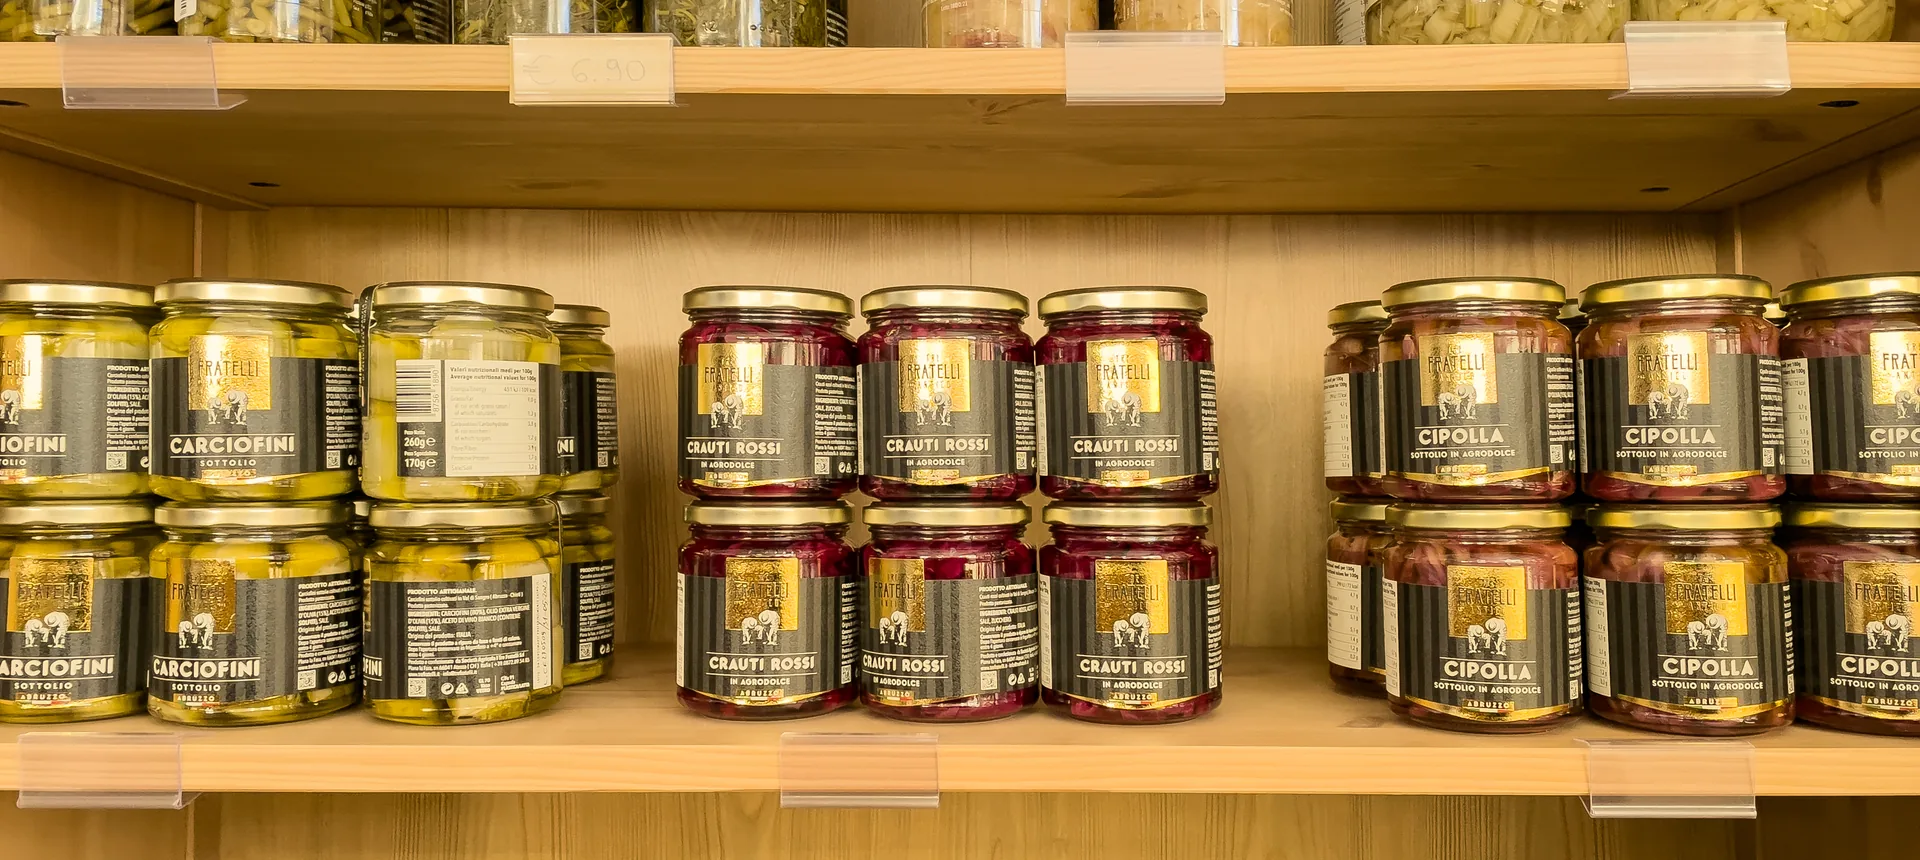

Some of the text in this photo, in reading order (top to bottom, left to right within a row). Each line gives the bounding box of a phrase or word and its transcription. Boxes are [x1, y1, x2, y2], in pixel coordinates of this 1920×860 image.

[571, 58, 646, 83] 6.90
[1428, 354, 1485, 373] FRATELLI
[1637, 353, 1698, 371] FRATELLI
[1882, 353, 1918, 370] FRAT
[199, 361, 259, 377] FRATELLI
[704, 366, 753, 383] FRATELLI
[907, 364, 960, 381] FRATELLI
[1096, 364, 1150, 380] FRATELLI
[404, 437, 426, 448] 260g
[1418, 428, 1505, 445] CIPOLLA
[1625, 427, 1717, 444] CIPOLLA
[170, 436, 295, 454] CARCIOFINI
[687, 441, 781, 455] CRAUTI ROSSI
[886, 438, 989, 452] CRAUTI ROSSI
[1073, 439, 1178, 453] CRAUTI ROSSI
[1410, 449, 1516, 459] SOTTOLIO IN AGRODOLCE
[1616, 450, 1657, 458] SOTTOLIO
[1672, 450, 1728, 458] AGRODOLCE
[200, 459, 256, 467] SOTTOLIO
[404, 459, 426, 470] 170g
[700, 461, 755, 469] IN AGRODOLCE
[916, 458, 966, 466] AGRODOLCE
[873, 581, 916, 600] FRATELLI
[1105, 583, 1159, 601] FRATELLI
[1457, 586, 1516, 606] FRATELLI
[1676, 583, 1737, 602] FRATELLI
[1855, 583, 1919, 603] FRATELLI
[153, 658, 260, 678] CARCIOFINI
[709, 655, 815, 671] CRAUTI ROSSI
[863, 654, 945, 673] CRAUTI ROSSI
[1080, 660, 1186, 674] CRAUTI ROSSI
[1444, 660, 1532, 680] CIPOLLA
[1663, 658, 1754, 676] CIPOLLA
[1841, 656, 1920, 677] CIPOLL
[14, 682, 73, 690] SOTTOLIO
[172, 683, 221, 692] SOTTOLIO
[740, 677, 790, 686] AGRODOLCE
[879, 677, 920, 687] AGRODOLCE
[1113, 681, 1163, 689] AGRODOLCE
[1433, 681, 1541, 694] SOTTOLIO IN AGRODOLCE
[1651, 679, 1764, 690] SOTTOLIO IN AGRODOLCE
[1830, 677, 1876, 689] SOTTOLIO
[1892, 683, 1920, 691] AGRO
[740, 689, 779, 697] ABRUZZO
[879, 689, 910, 697] ABRUZZO
[1113, 692, 1152, 700] ABRUZZO
[1467, 701, 1509, 709] ABRUZZO
[1866, 697, 1913, 706] ABRUZZO
